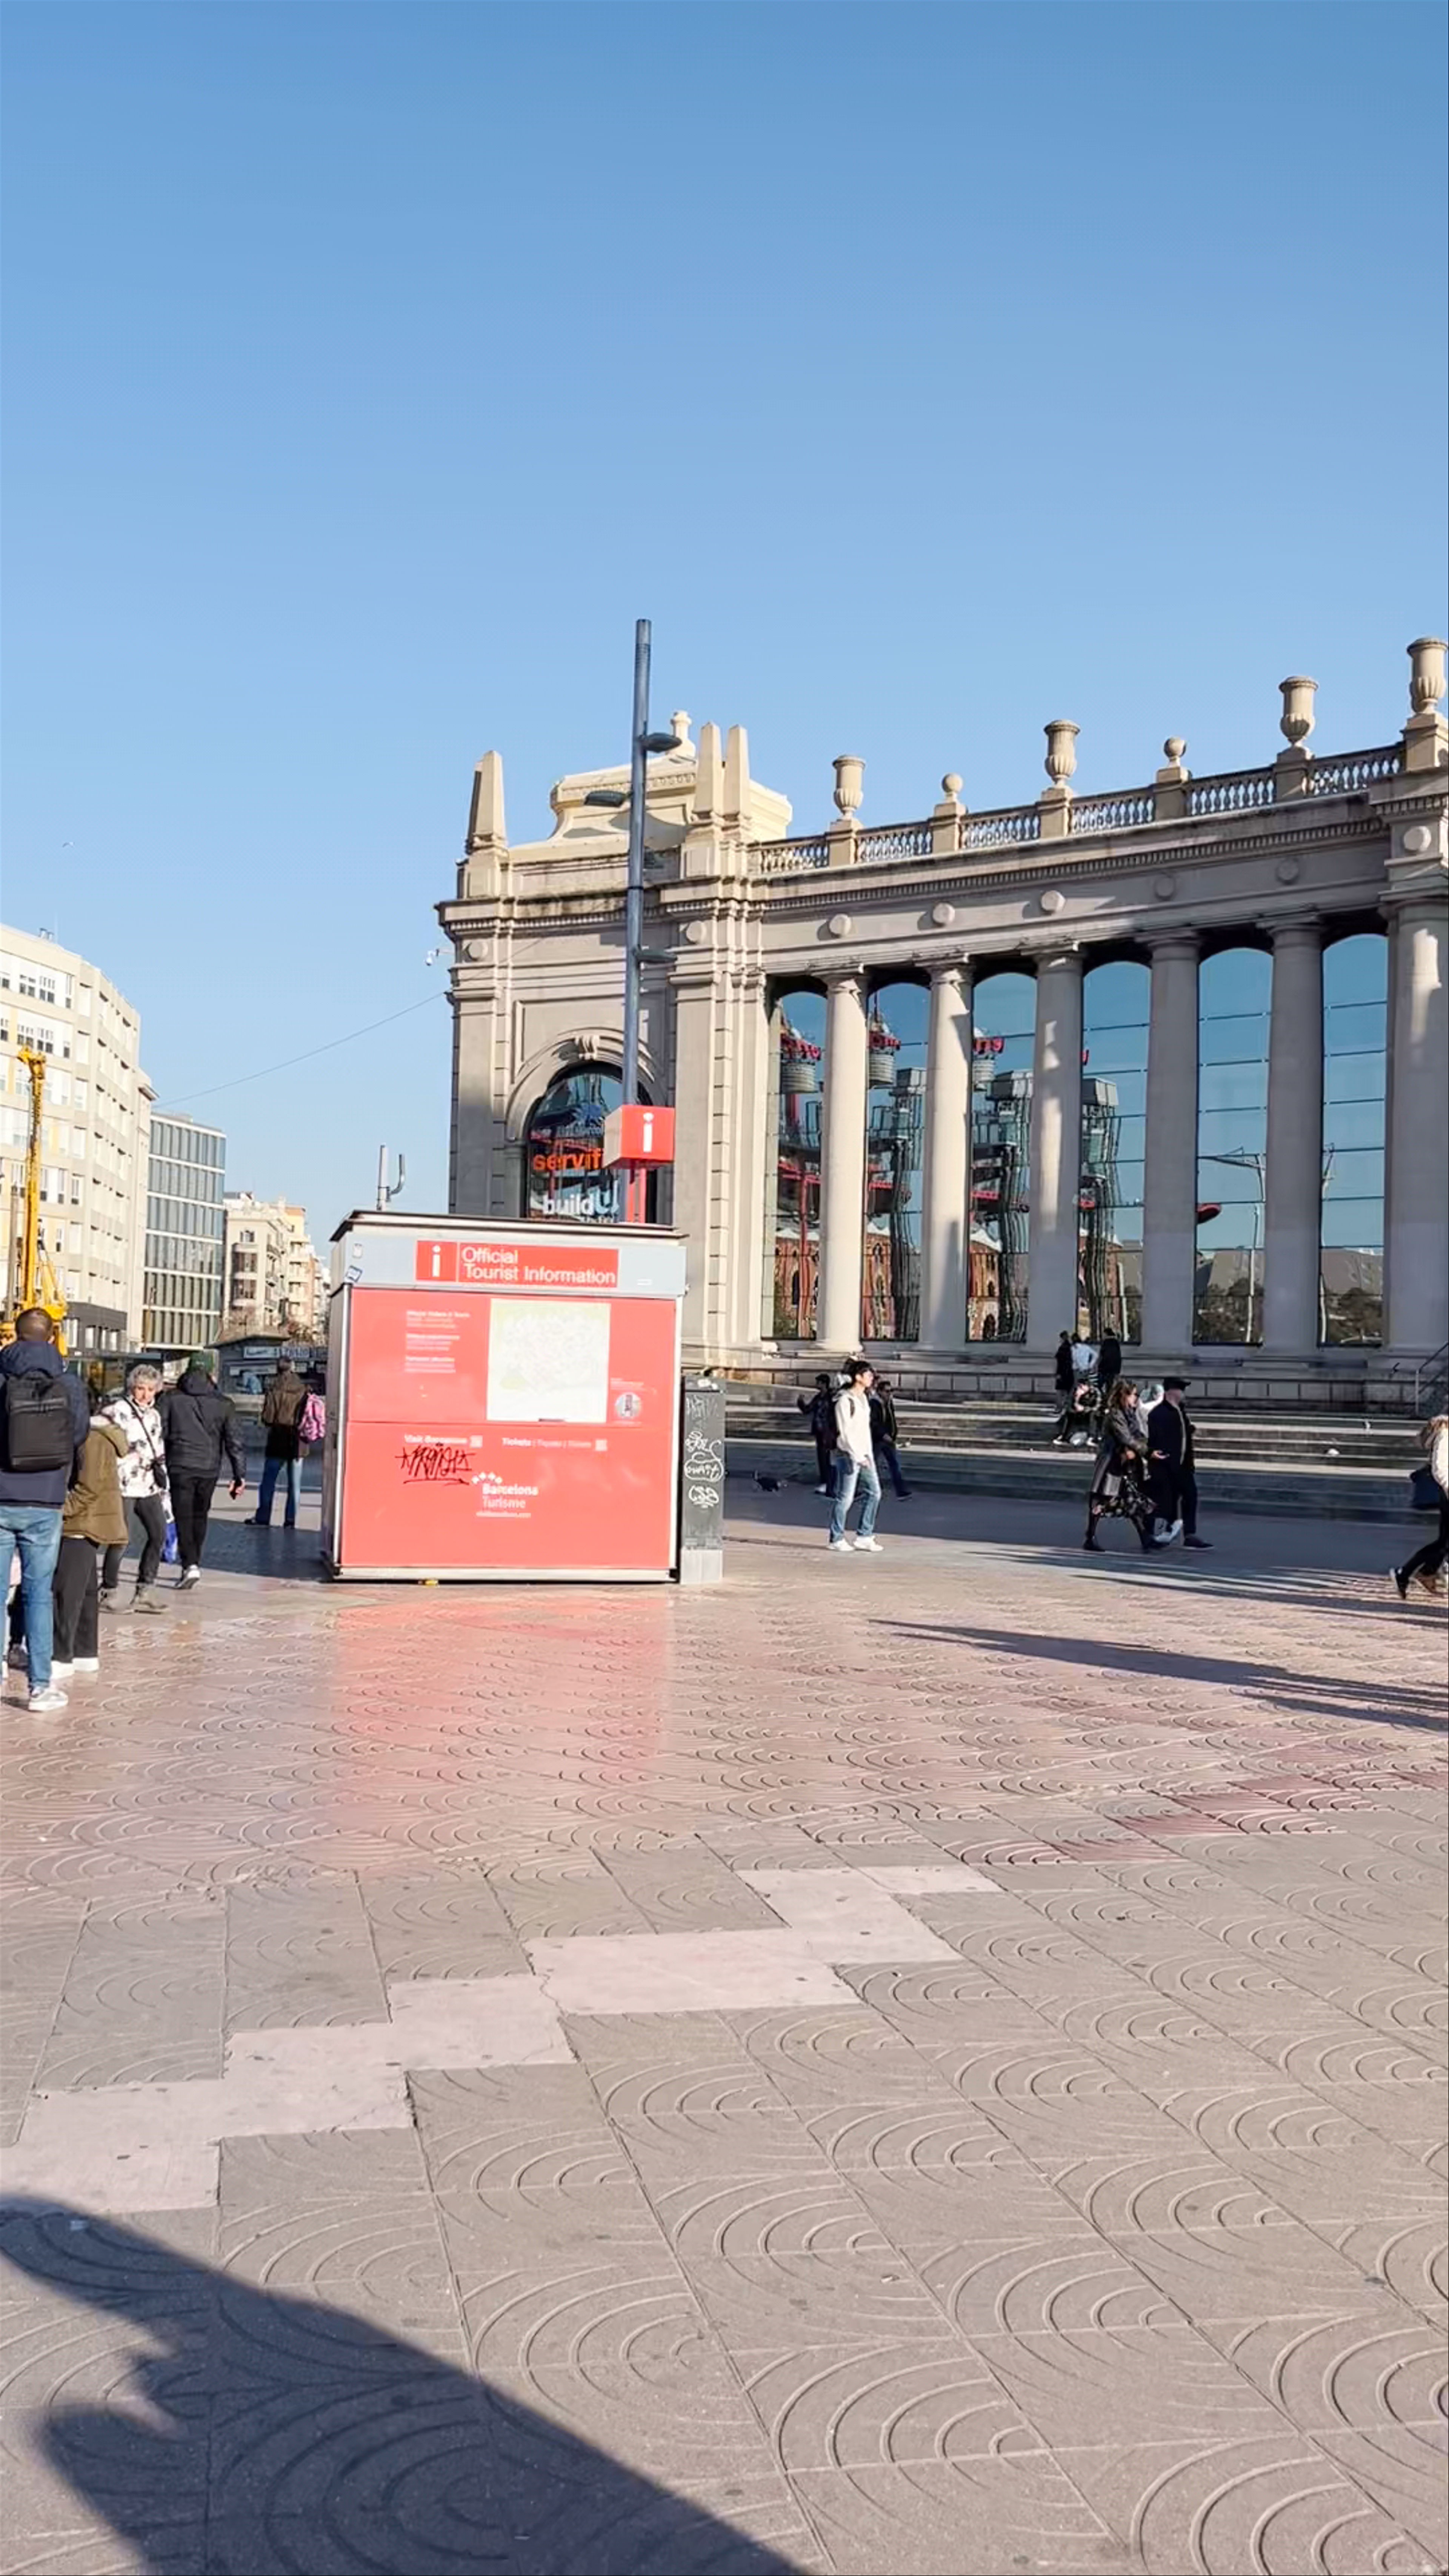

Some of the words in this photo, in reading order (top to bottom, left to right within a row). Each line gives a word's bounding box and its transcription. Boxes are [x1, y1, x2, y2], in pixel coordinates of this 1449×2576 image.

[533, 1147, 605, 1171] servif
[462, 1247, 518, 1263] Official
[464, 1263, 518, 1281] Tourist
[525, 1266, 616, 1284] Information
[502, 1437, 531, 1446] Tickets
[483, 1483, 538, 1496] Barcelona
[483, 1496, 526, 1508] Turisme
